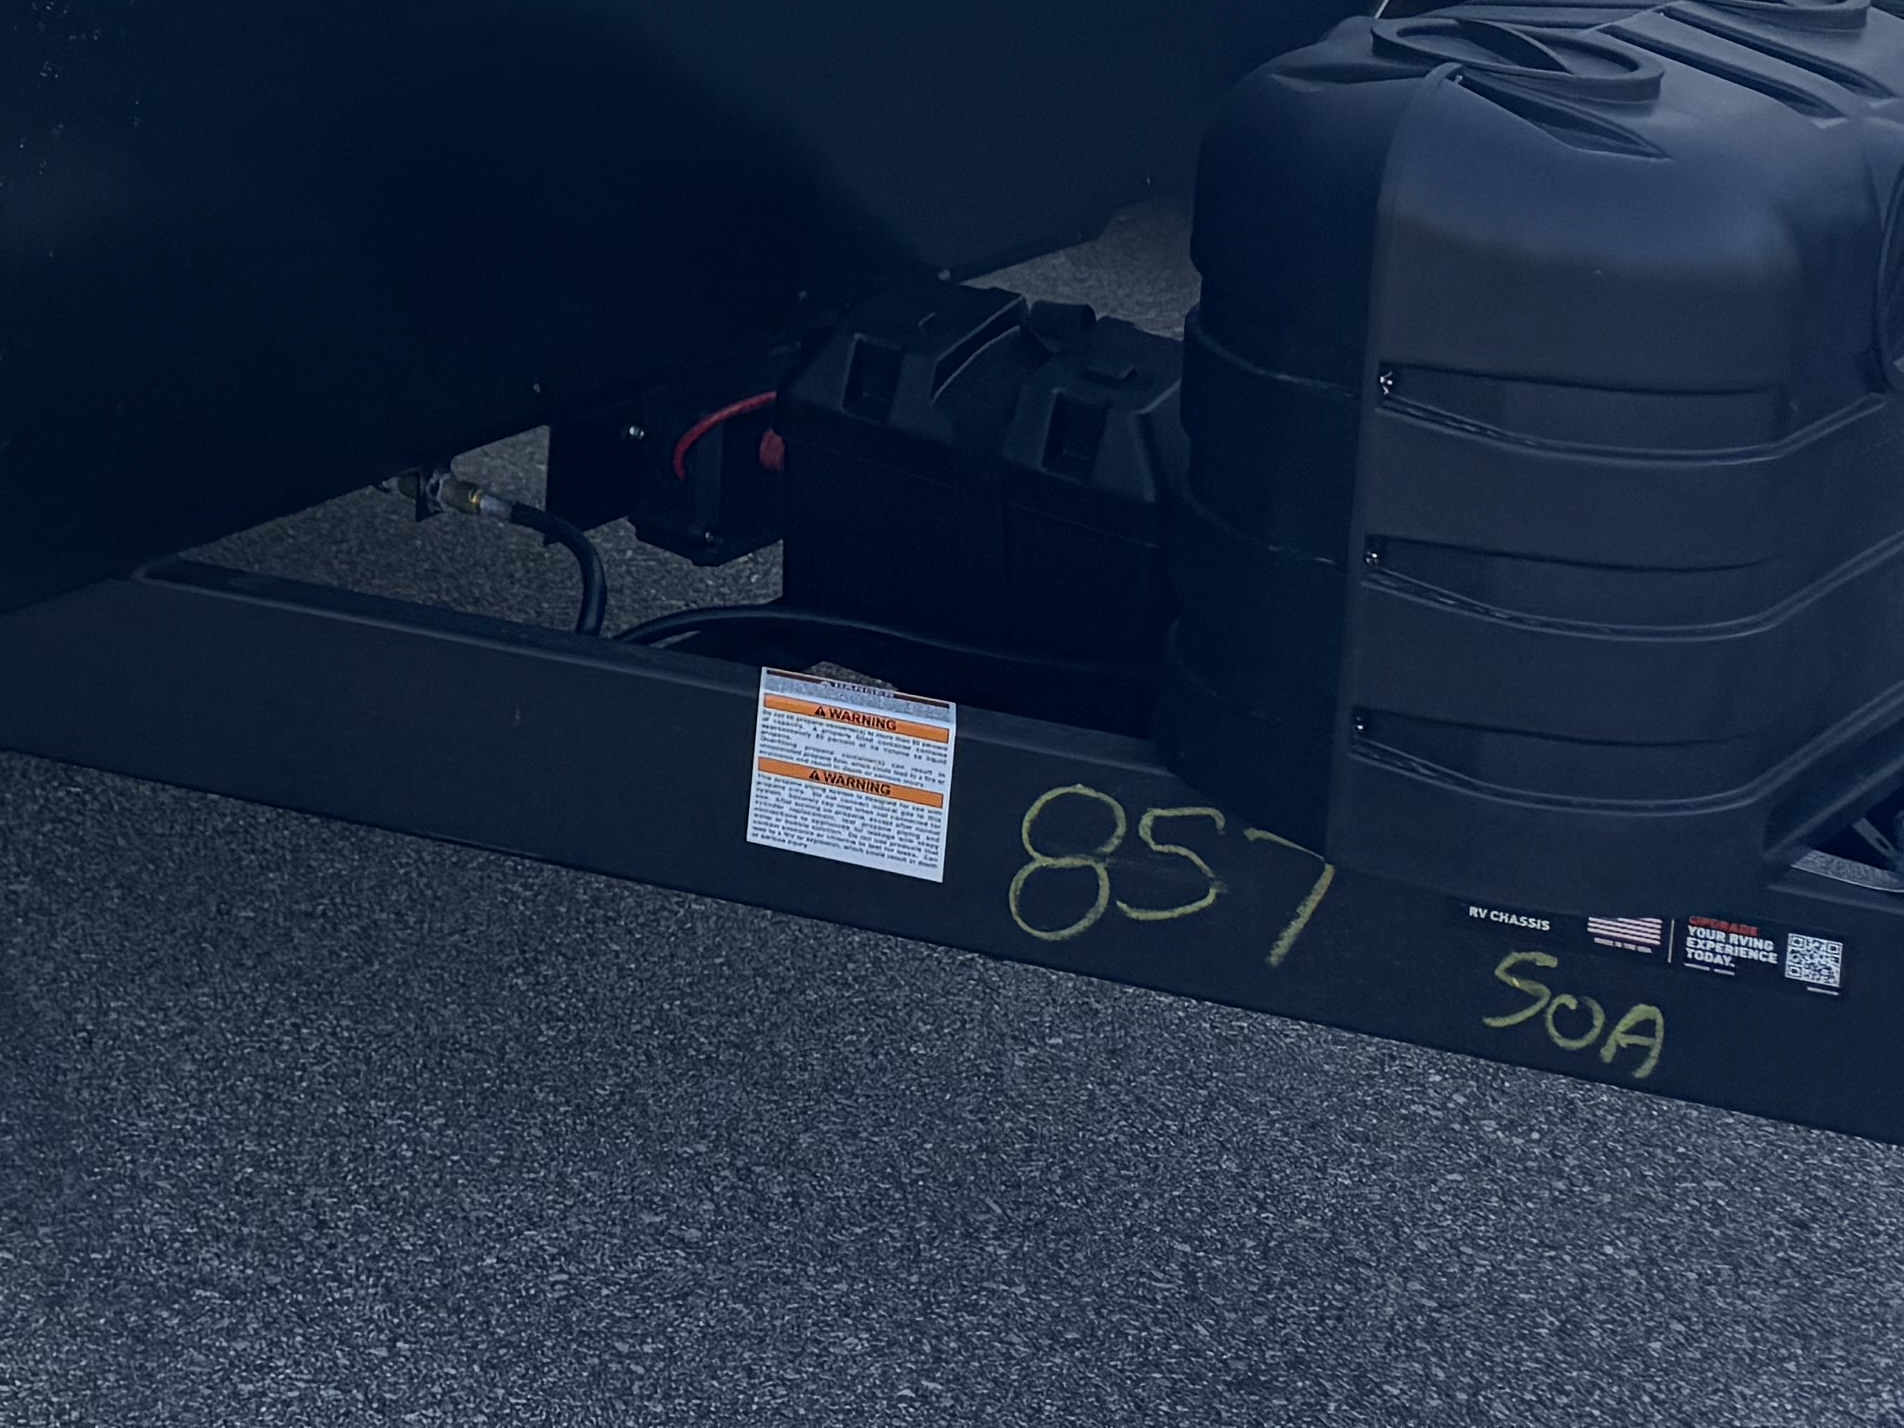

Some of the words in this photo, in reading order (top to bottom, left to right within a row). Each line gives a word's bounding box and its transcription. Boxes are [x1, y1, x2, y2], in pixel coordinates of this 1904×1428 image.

[829, 708, 896, 730] WARNING
[823, 772, 891, 795] WARNING
[1009, 783, 1334, 967] 857
[1469, 906, 1488, 919] RV
[1490, 910, 1551, 931] CHASSIS
[1686, 937, 1778, 964] EXPERIENCE
[1687, 925, 1726, 943] YOUR
[1729, 933, 1774, 951] RVING
[1685, 948, 1736, 967] TODAY.
